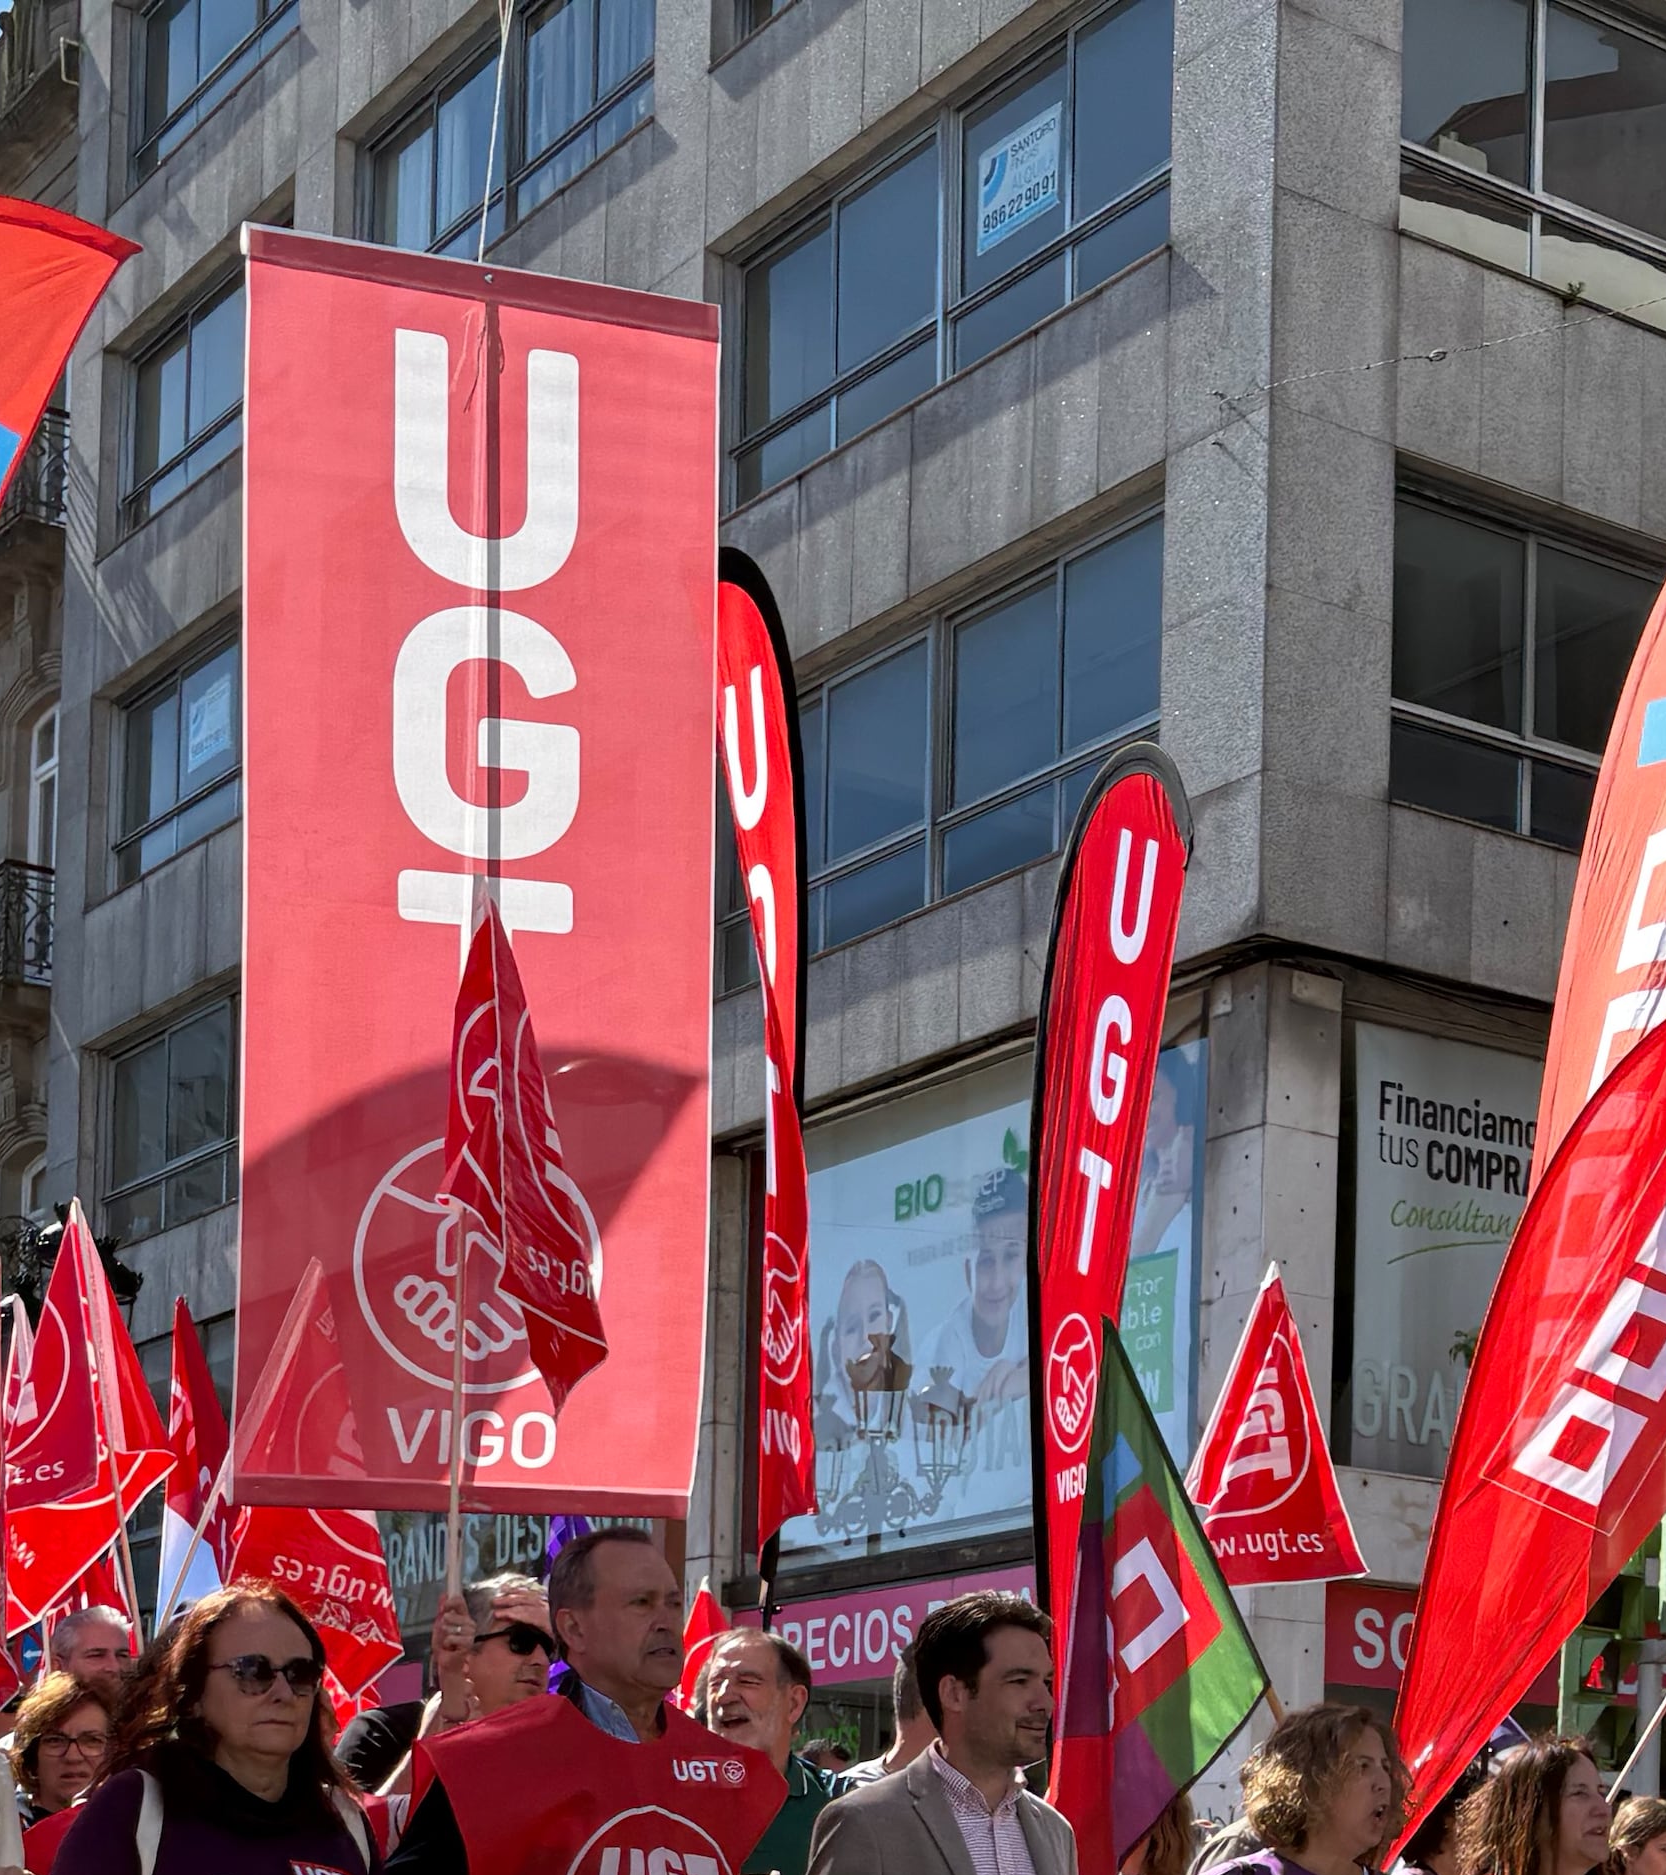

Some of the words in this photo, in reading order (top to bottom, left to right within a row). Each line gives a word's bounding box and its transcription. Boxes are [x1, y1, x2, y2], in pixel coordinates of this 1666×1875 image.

[1079, 828, 1159, 1277] UGT
[1379, 1126, 1419, 1168] tus
[388, 1408, 557, 1470] VIGO
[1056, 1463, 1087, 1504] VIGO
[673, 1759, 718, 1784] UGT
